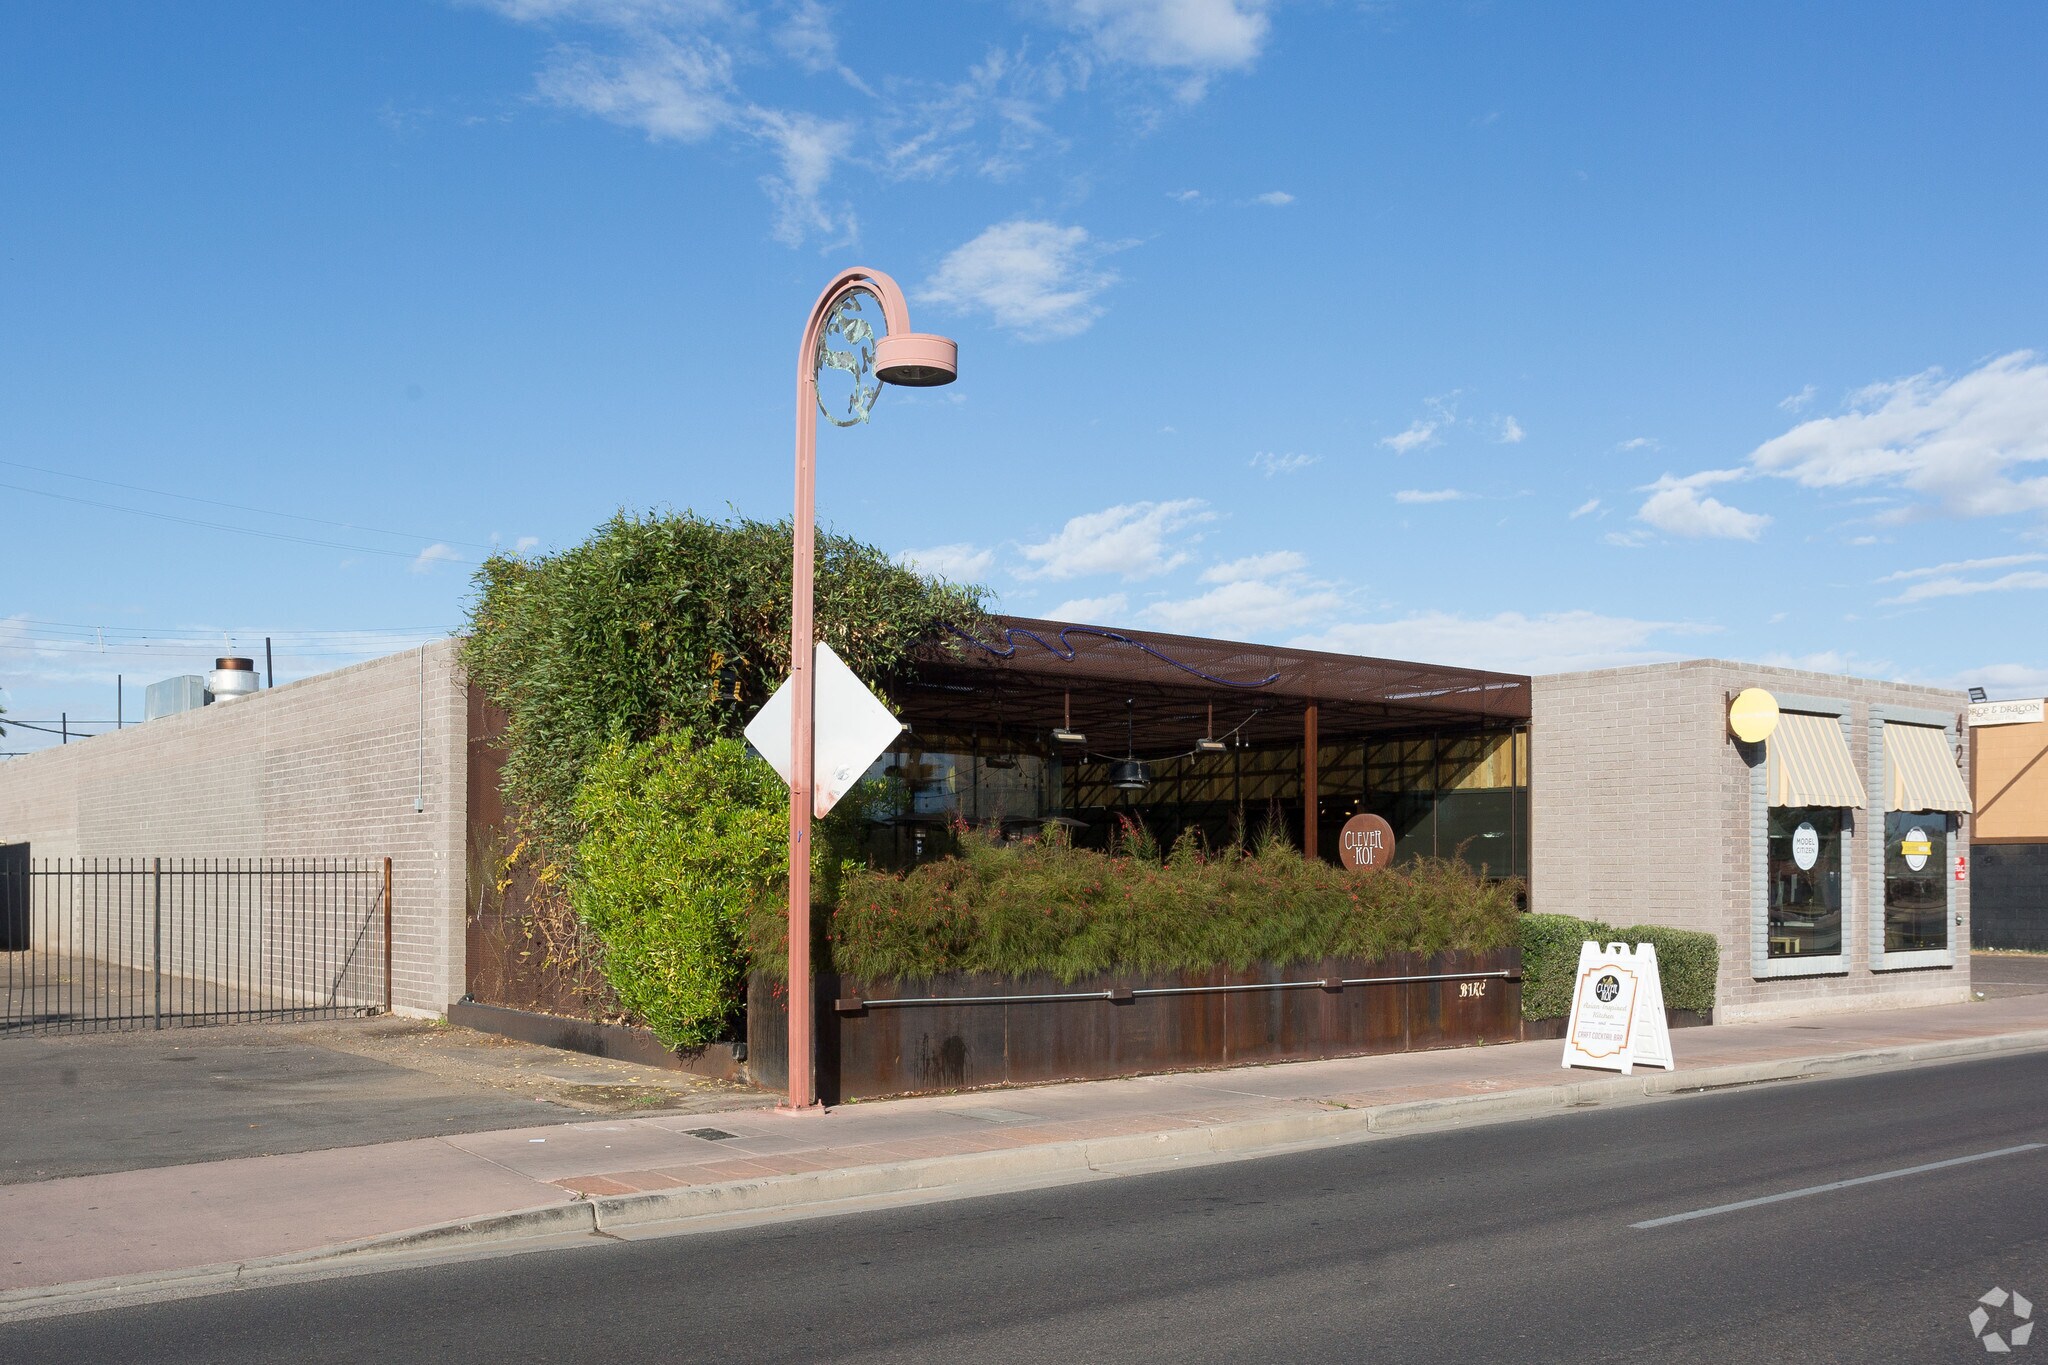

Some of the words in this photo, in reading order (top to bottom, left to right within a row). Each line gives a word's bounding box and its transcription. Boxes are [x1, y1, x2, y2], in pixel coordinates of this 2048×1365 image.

[1991, 705, 1997, 714] &
[1344, 830, 1384, 850] CLEVER
[1796, 837, 1815, 846] MODEL
[1597, 984, 1617, 994] CLEVER
[1600, 991, 1611, 1001] KOI
[1578, 1031, 1591, 1039] CRAFT
[1592, 1031, 1613, 1040] COCKTAIL
